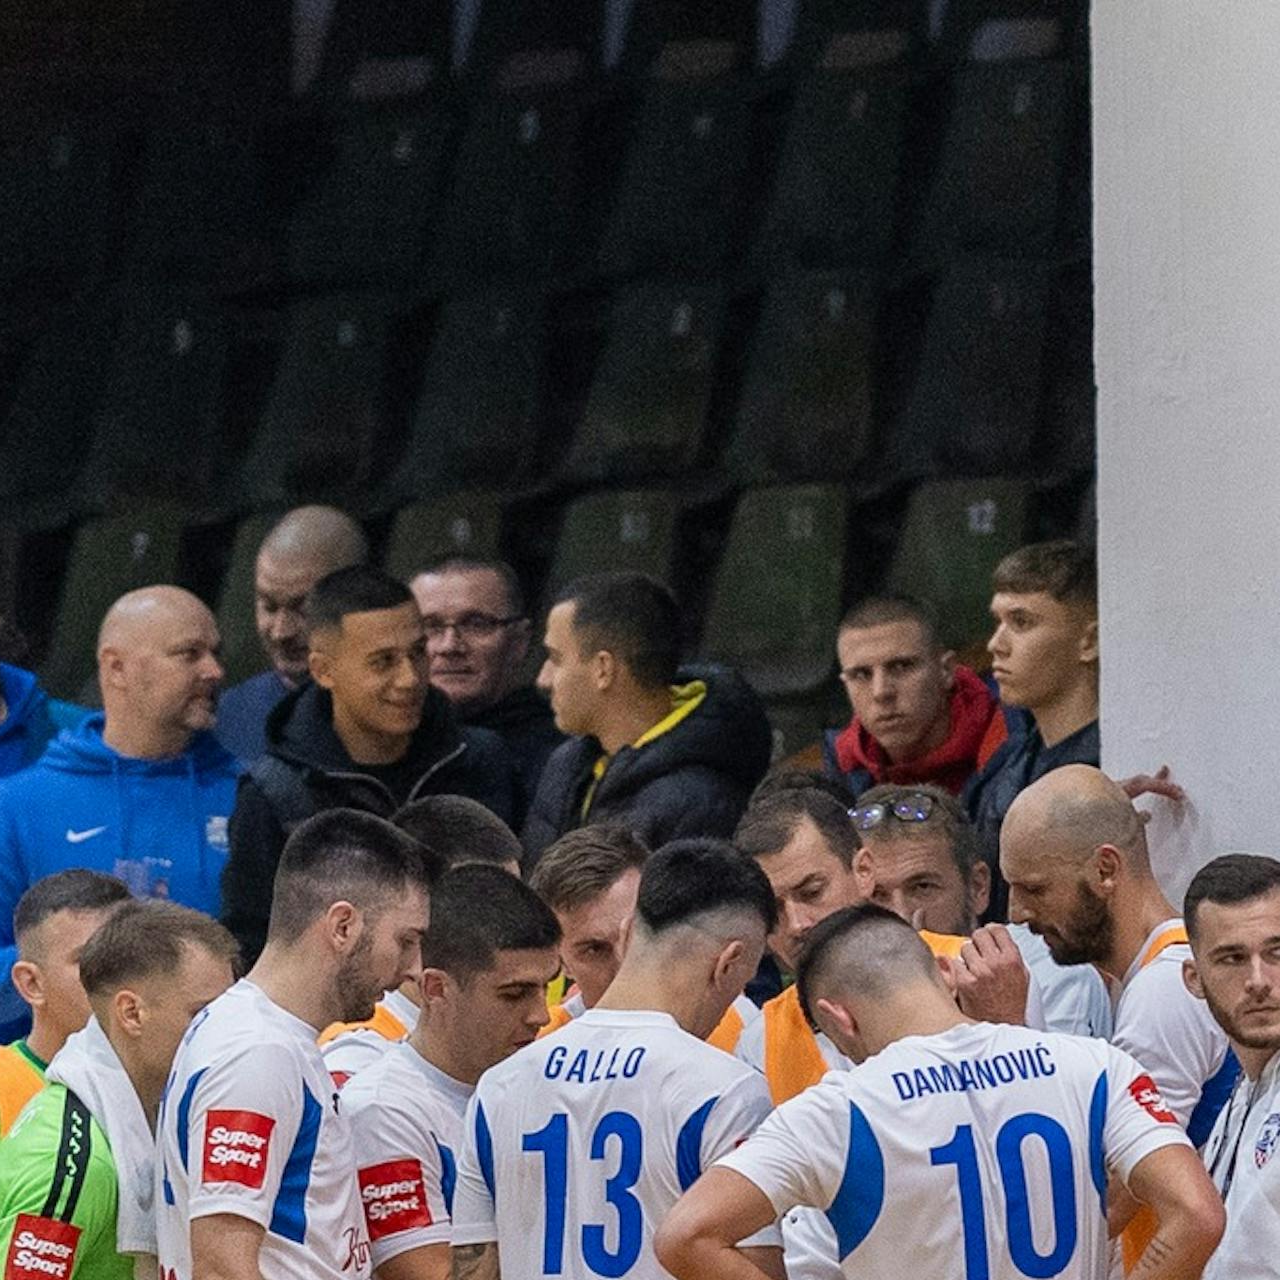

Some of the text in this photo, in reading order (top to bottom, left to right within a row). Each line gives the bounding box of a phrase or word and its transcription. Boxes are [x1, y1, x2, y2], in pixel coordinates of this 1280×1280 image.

[543, 1046, 646, 1084] GALLO
[890, 1042, 1056, 1101] DAMJANOVIĆ
[207, 1126, 267, 1150] Super
[208, 1145, 262, 1168] Sport
[361, 1180, 420, 1203] Super
[522, 1111, 643, 1279] 13
[367, 1196, 419, 1220] Sport
[14, 1230, 73, 1260] Super
[13, 1249, 67, 1278] Sport
